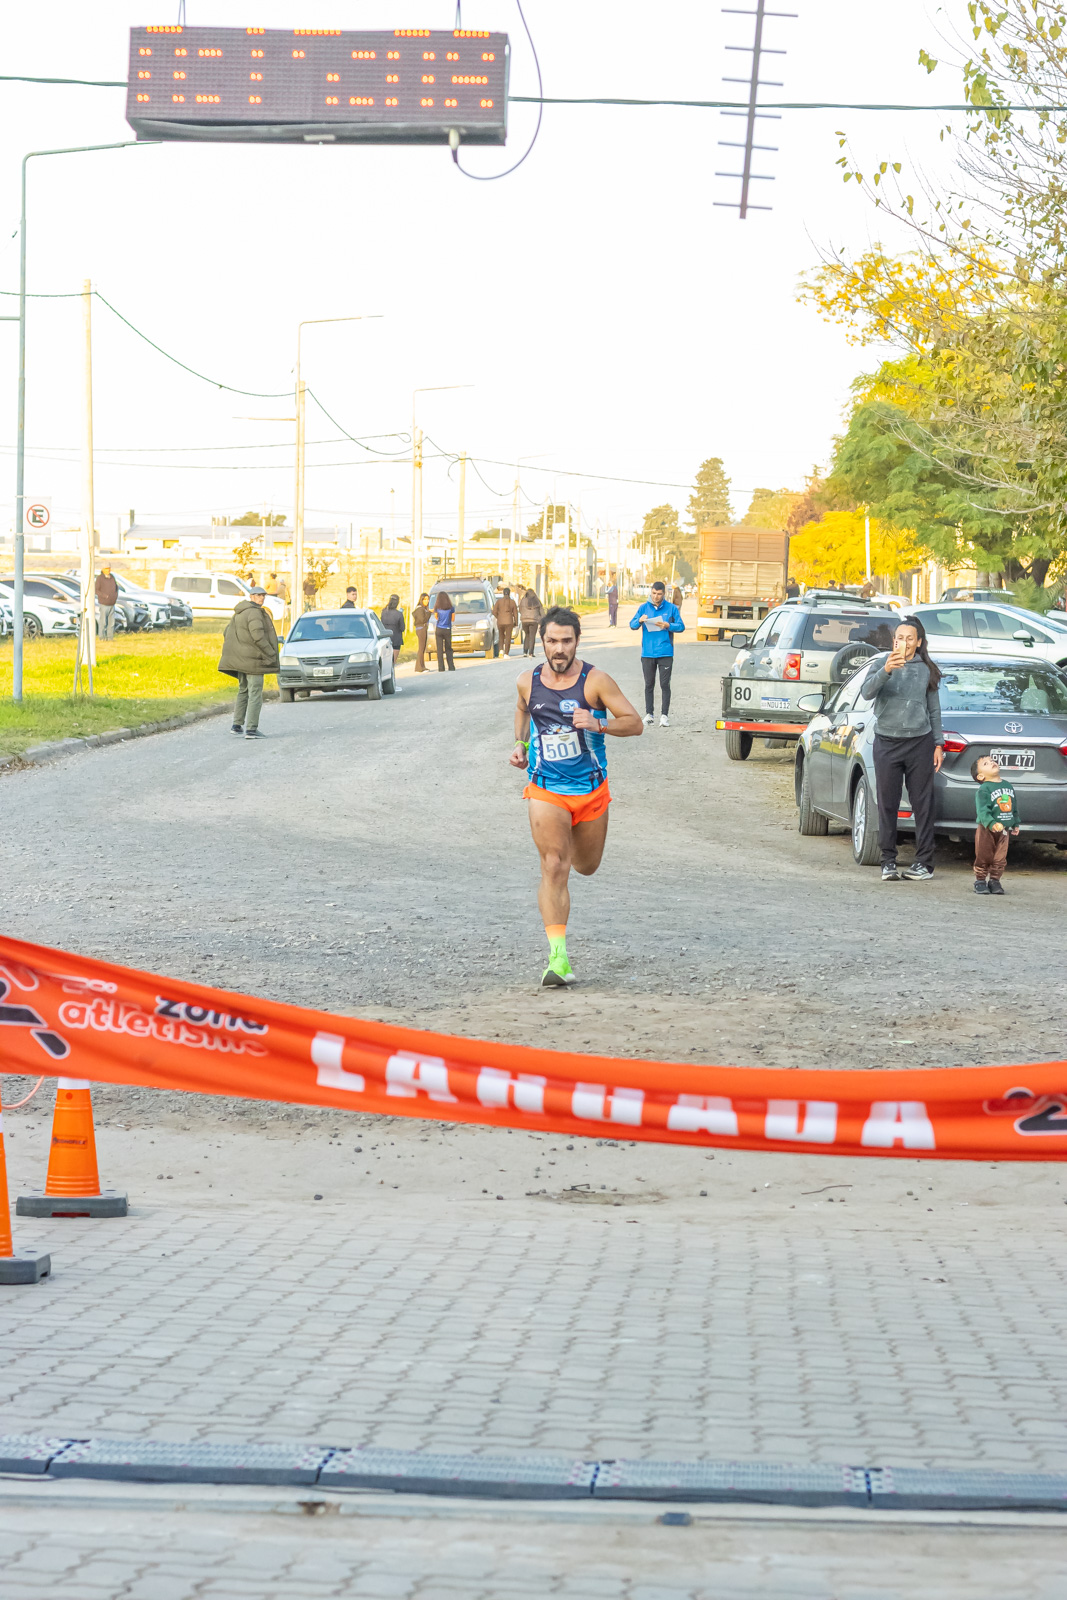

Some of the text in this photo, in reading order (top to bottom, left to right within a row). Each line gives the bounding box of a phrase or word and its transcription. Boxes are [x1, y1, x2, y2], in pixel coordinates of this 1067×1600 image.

[734, 686, 751, 701] 80
[545, 741, 578, 759] 501
[1015, 755, 1034, 767] 477
